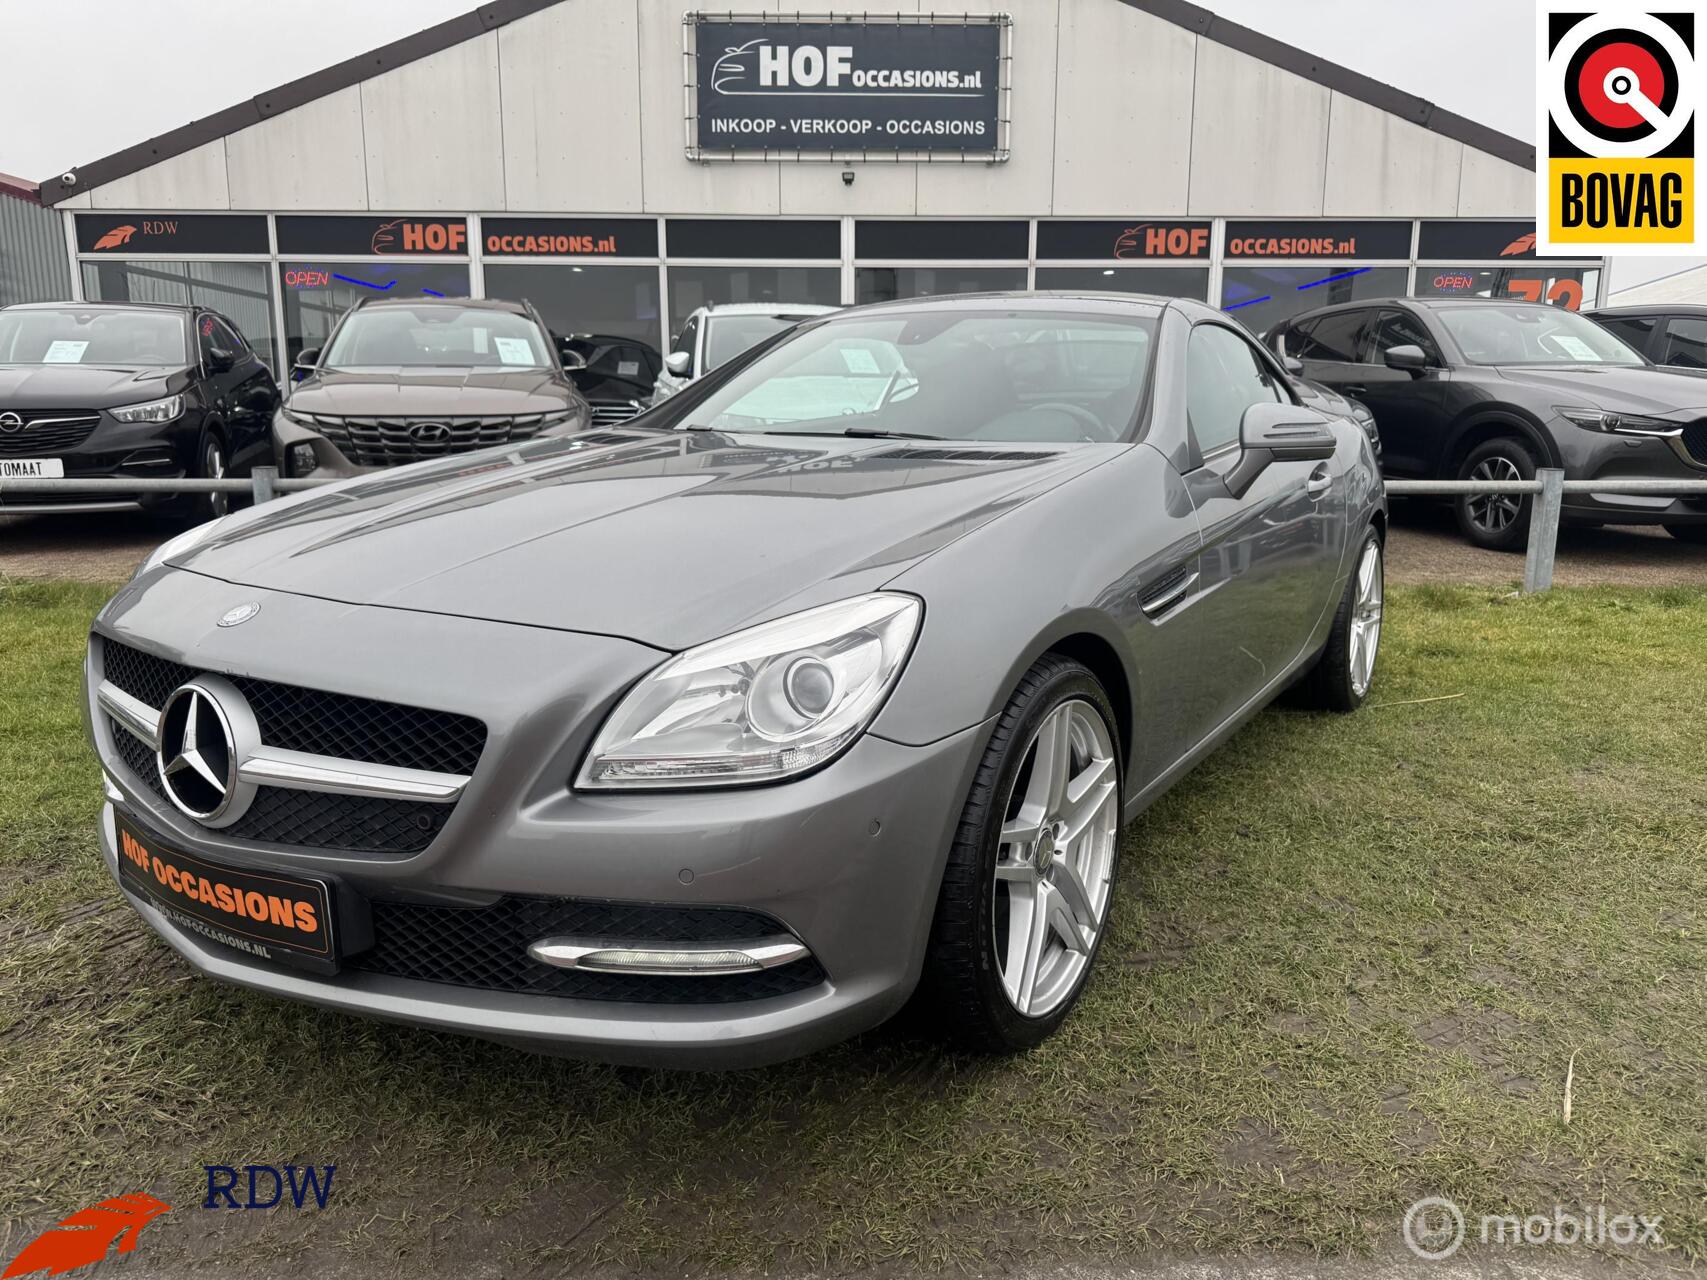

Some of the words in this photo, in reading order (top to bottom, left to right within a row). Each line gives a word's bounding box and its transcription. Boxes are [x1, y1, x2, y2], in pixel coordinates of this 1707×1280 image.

[711, 118, 776, 133] INKOOP
[790, 119, 872, 134] VERKOOP
[886, 120, 985, 135] OCCASIONS
[143, 221, 178, 235] RDW
[403, 224, 465, 250] HOF
[487, 236, 616, 252] OCCASIONS.nl
[1145, 228, 1208, 255] HOF
[1230, 238, 1355, 254] OCCASIONS.nl
[285, 271, 329, 286] OPEN
[1433, 276, 1473, 288] OPEN
[121, 828, 150, 873] HOF
[152, 856, 318, 933] OCCASIONS
